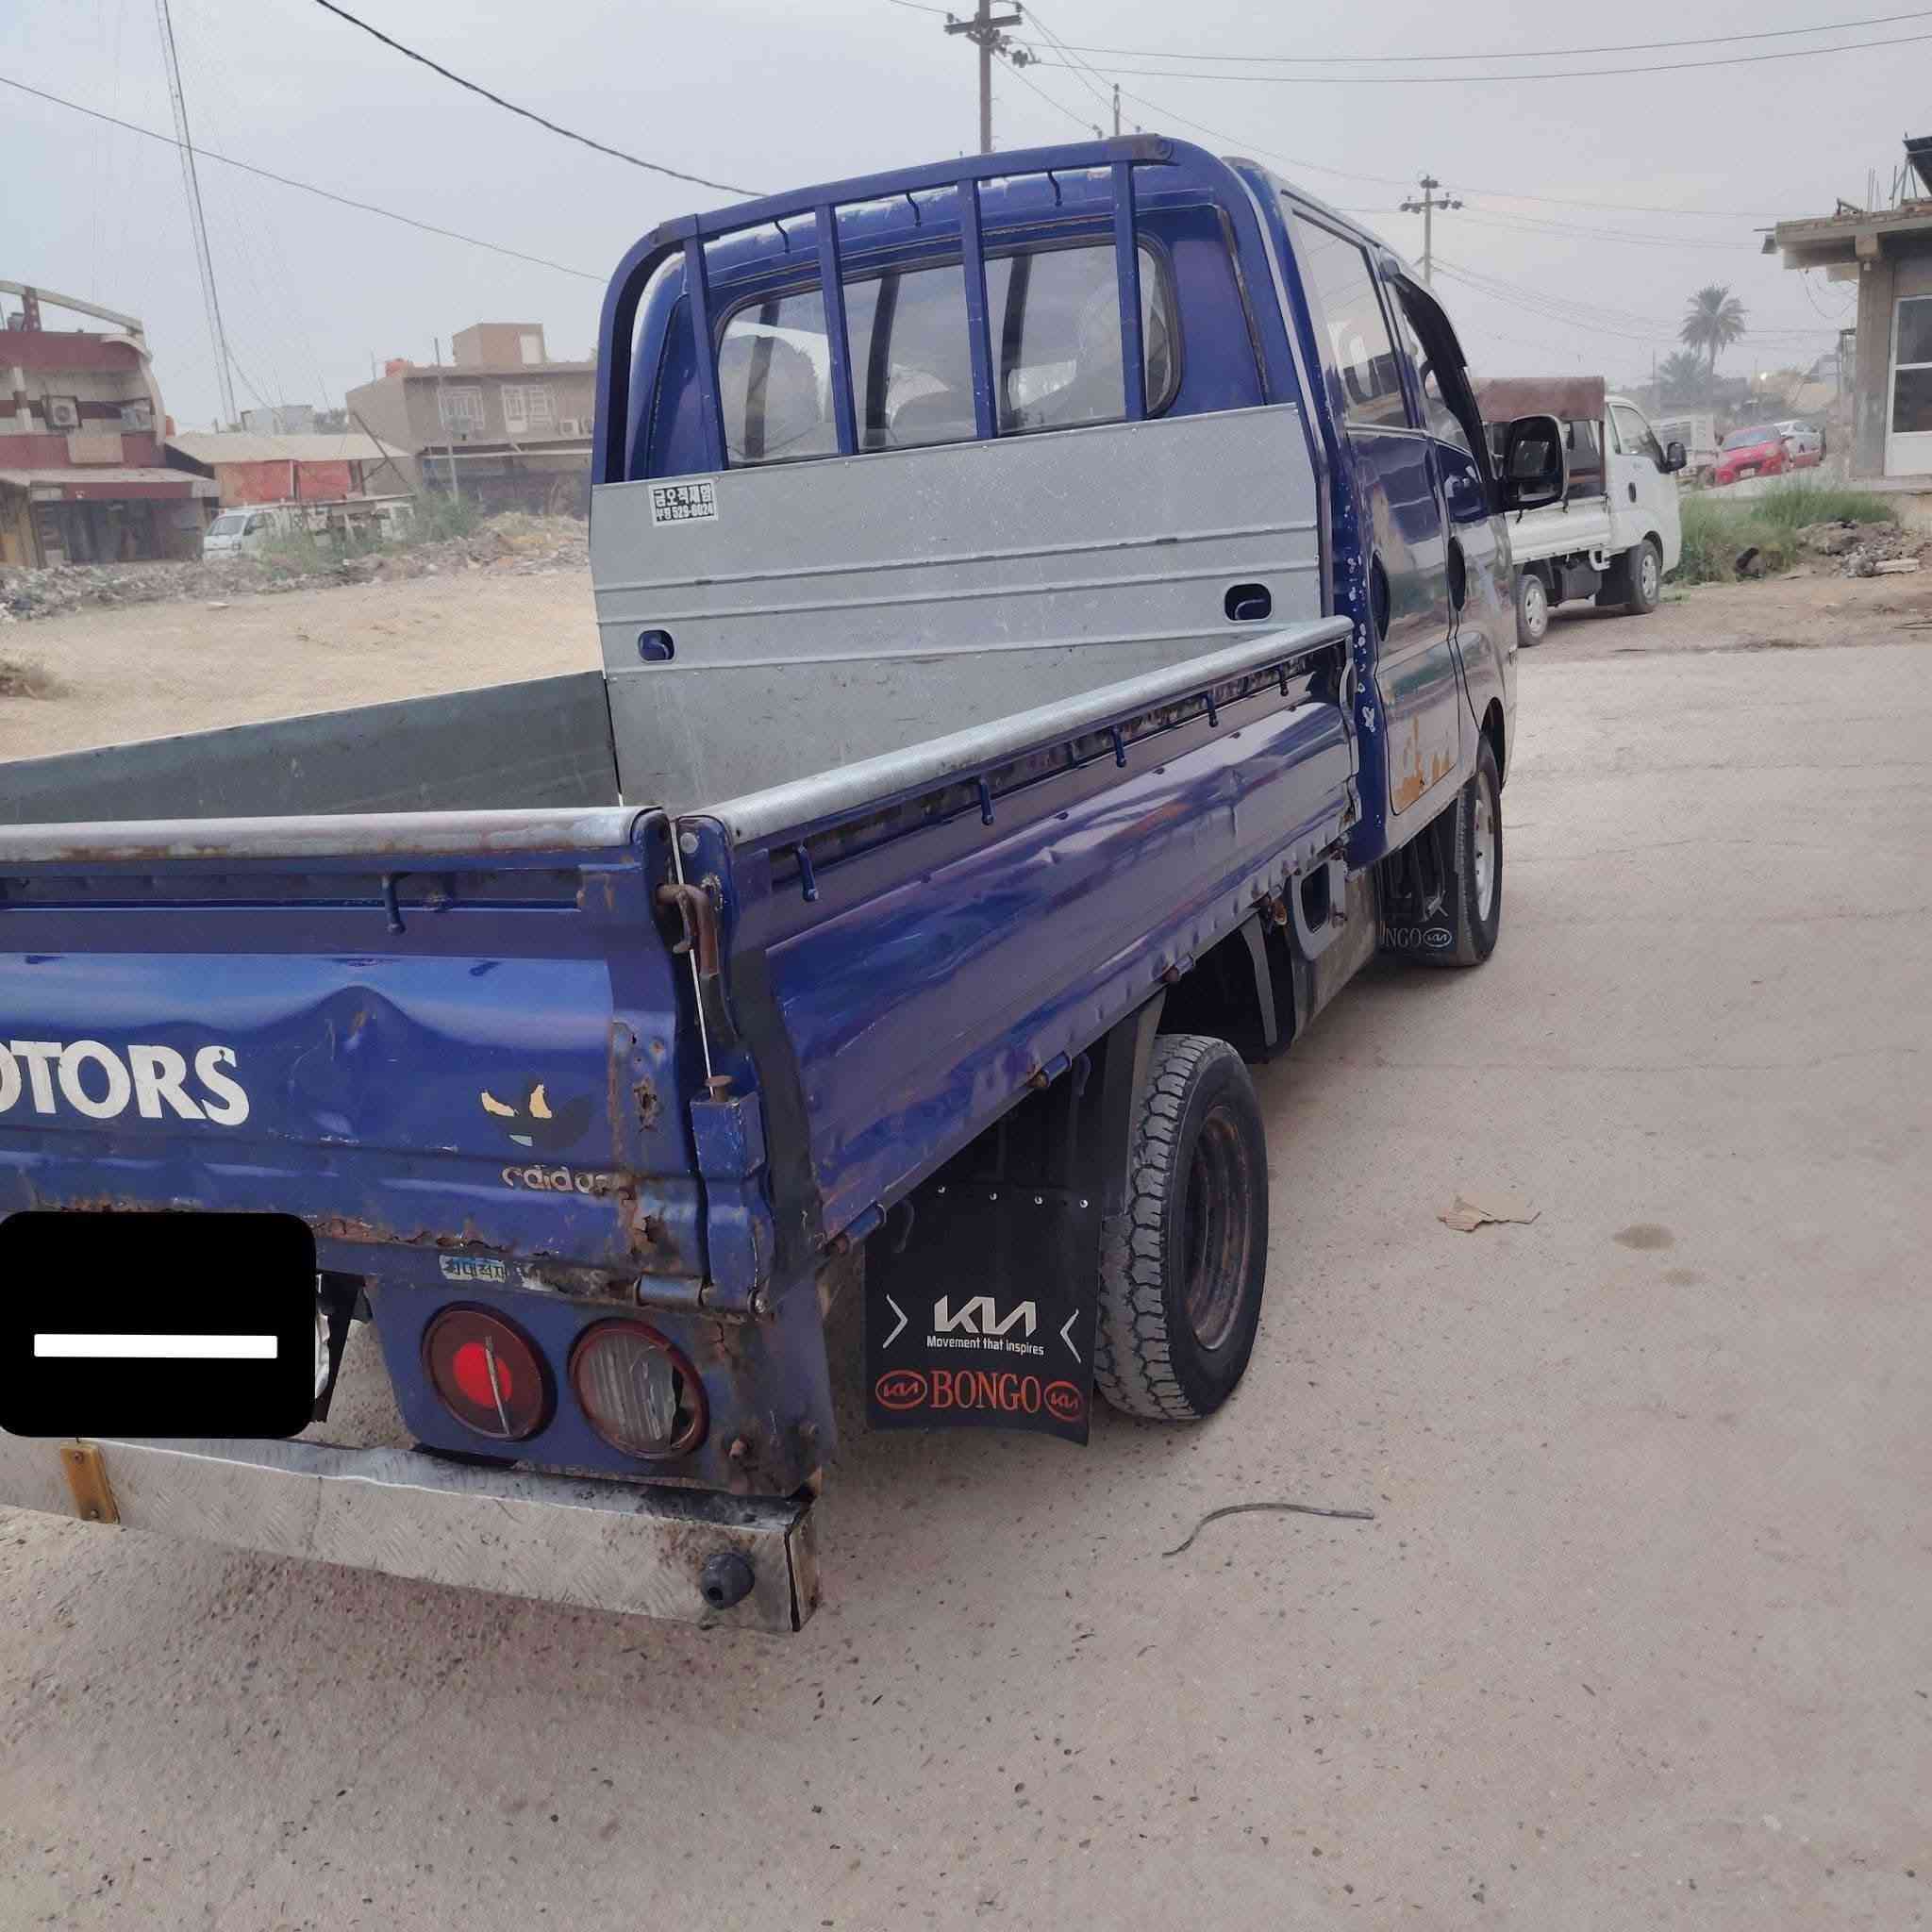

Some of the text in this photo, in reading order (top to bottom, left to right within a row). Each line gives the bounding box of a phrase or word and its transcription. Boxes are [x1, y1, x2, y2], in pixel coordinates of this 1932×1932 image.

[926, 1335, 1044, 1356] Movement that inspires
[929, 1369, 1042, 1413] BONGO
